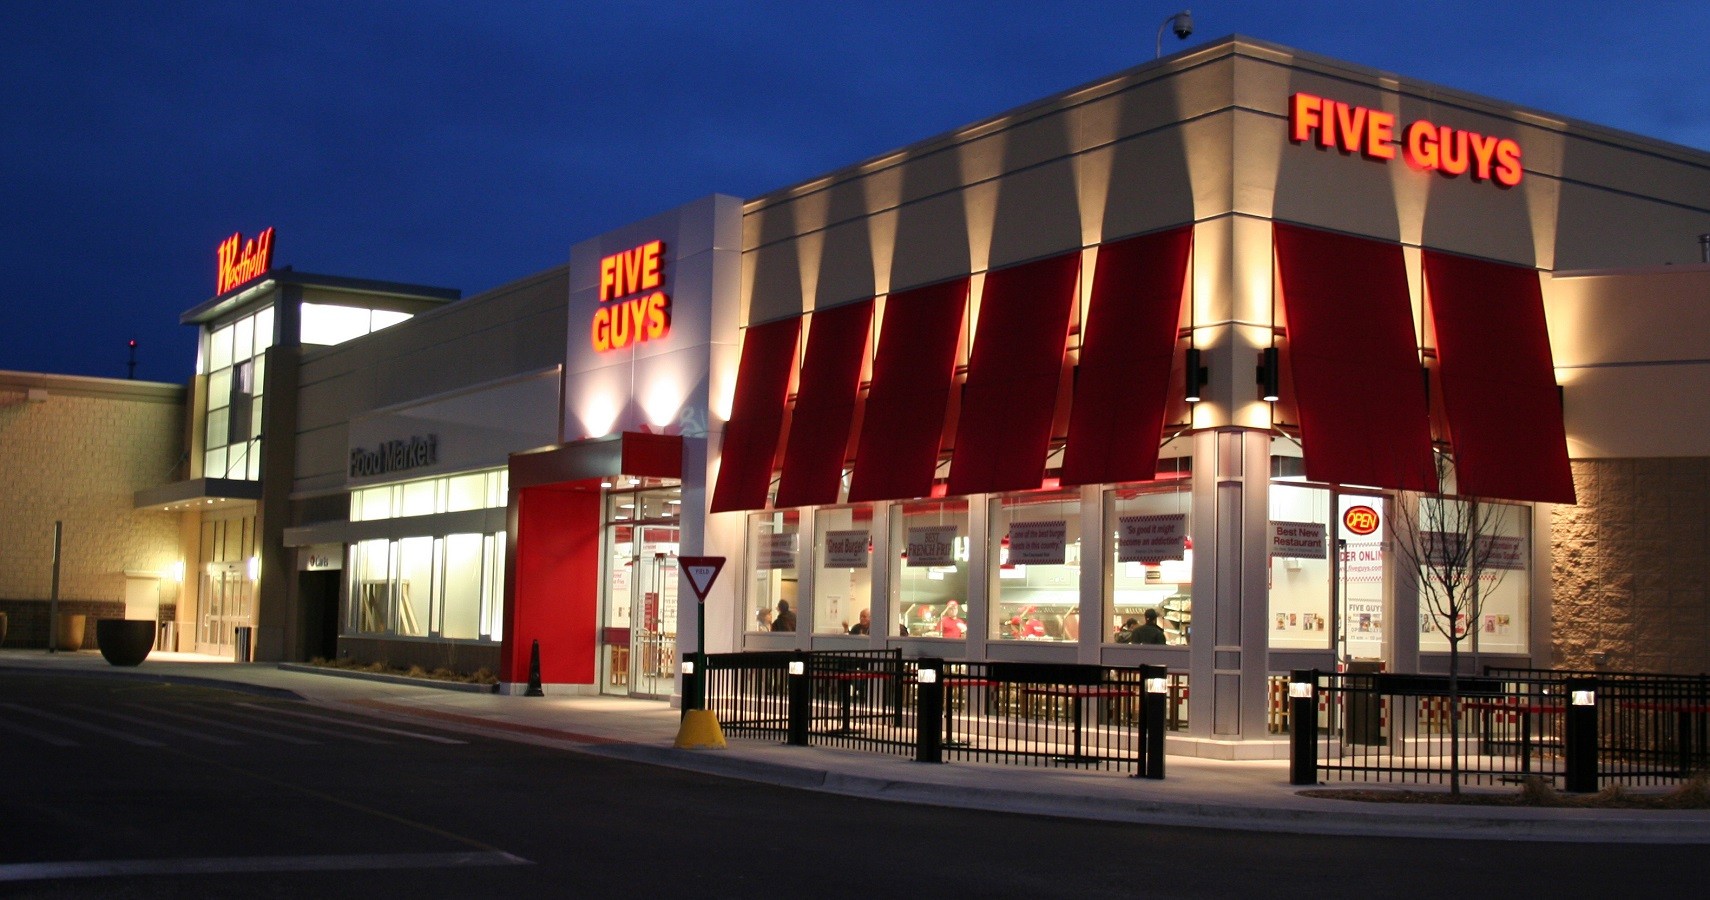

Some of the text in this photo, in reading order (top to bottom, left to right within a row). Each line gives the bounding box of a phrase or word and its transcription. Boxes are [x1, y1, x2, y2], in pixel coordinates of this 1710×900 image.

[1289, 92, 1523, 190] FIVE GUYS
[217, 226, 275, 296] Westfield
[599, 239, 664, 302] FIVE
[592, 291, 669, 353] GUYS
[350, 433, 438, 477] Food Market
[1346, 512, 1377, 529] OPEN
[1136, 525, 1151, 536] good
[1157, 524, 1175, 535] might
[1276, 526, 1319, 538] Best New
[924, 532, 940, 543] BEST
[1142, 538, 1150, 546] an
[1273, 536, 1322, 548] Restaurant
[908, 542, 936, 556] FRENCH
[1366, 604, 1382, 612] GUY
